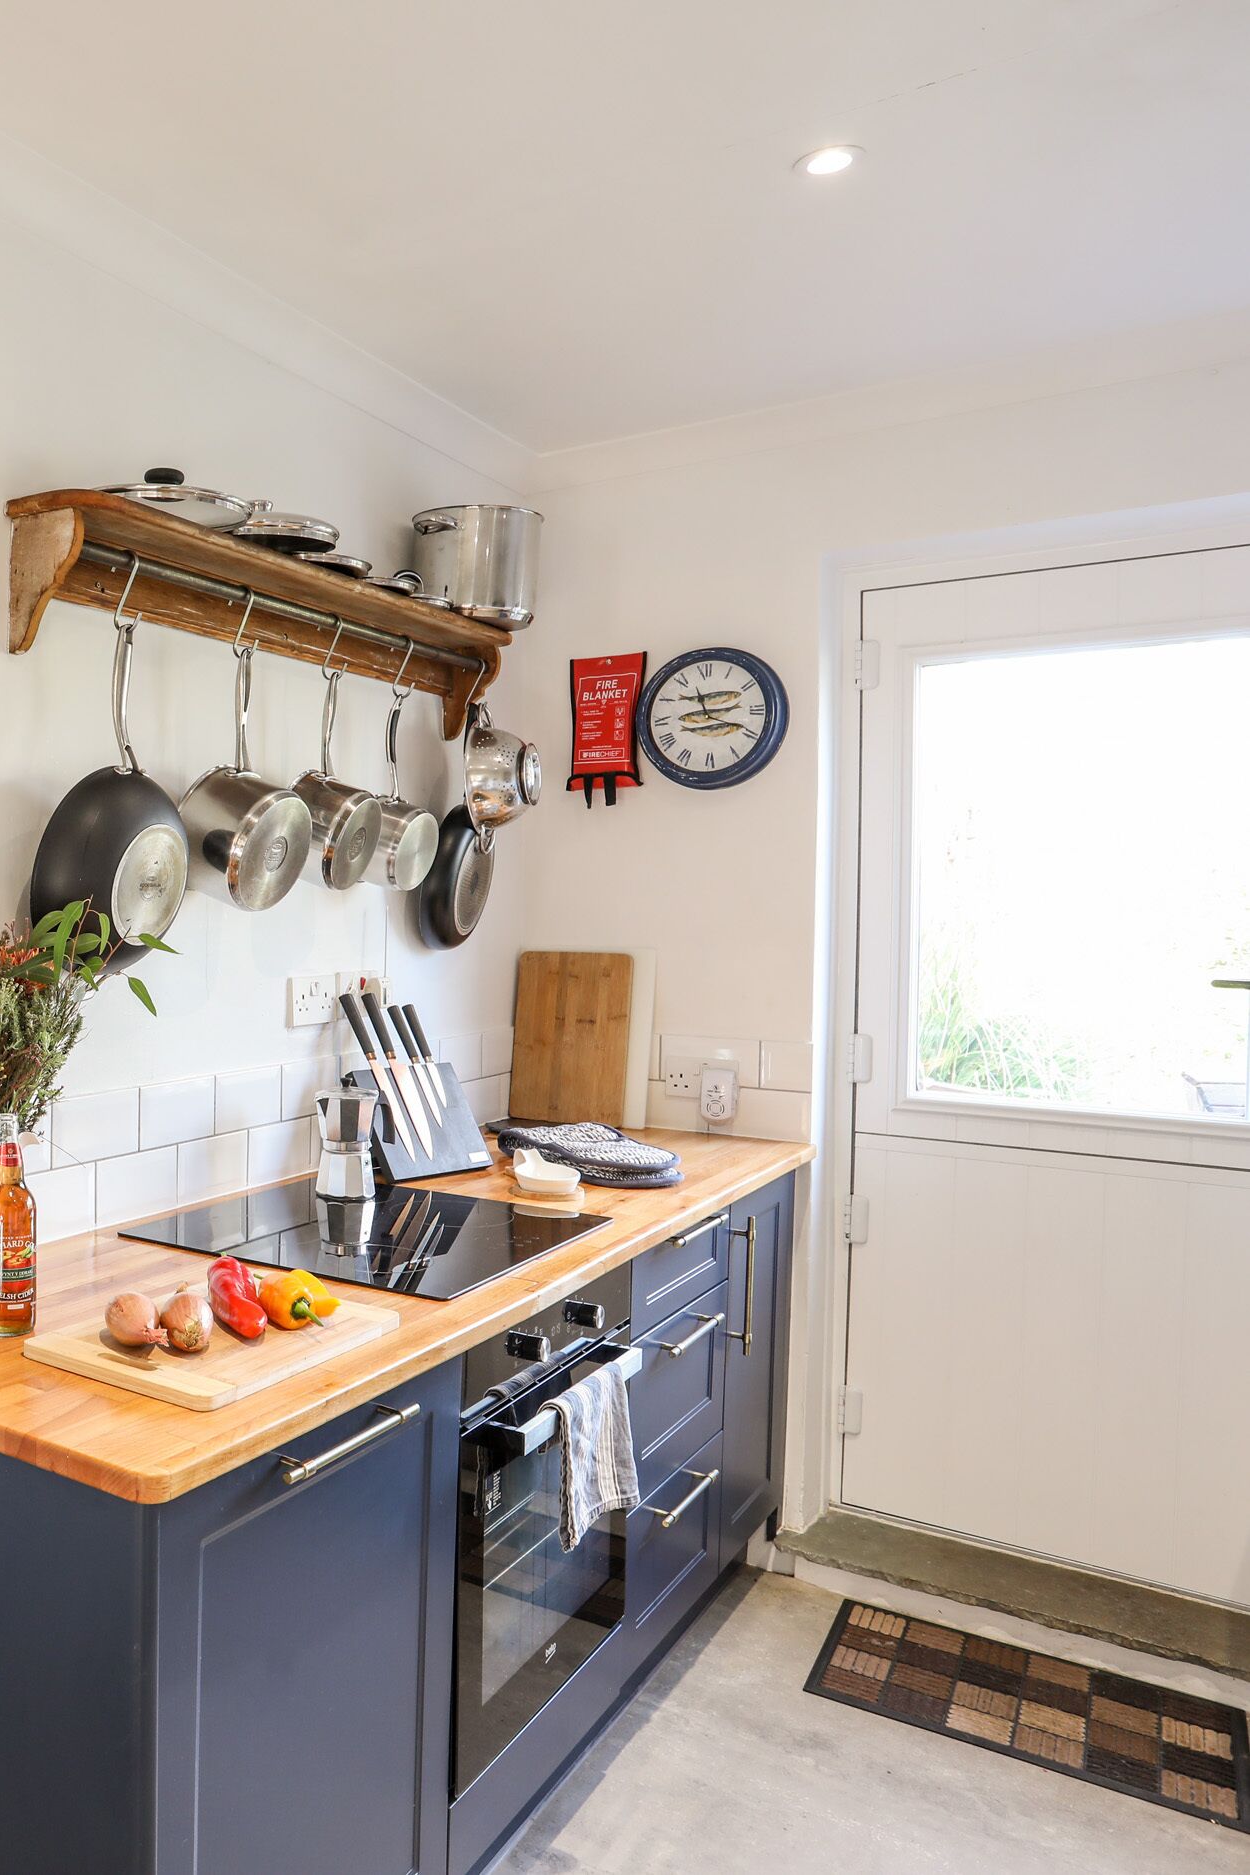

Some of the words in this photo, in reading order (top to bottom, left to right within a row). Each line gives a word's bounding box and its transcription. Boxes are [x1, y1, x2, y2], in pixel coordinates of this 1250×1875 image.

[595, 679, 618, 690] FIRE
[582, 688, 628, 701] BLANKET
[17, 1287, 35, 1300] CIDER
